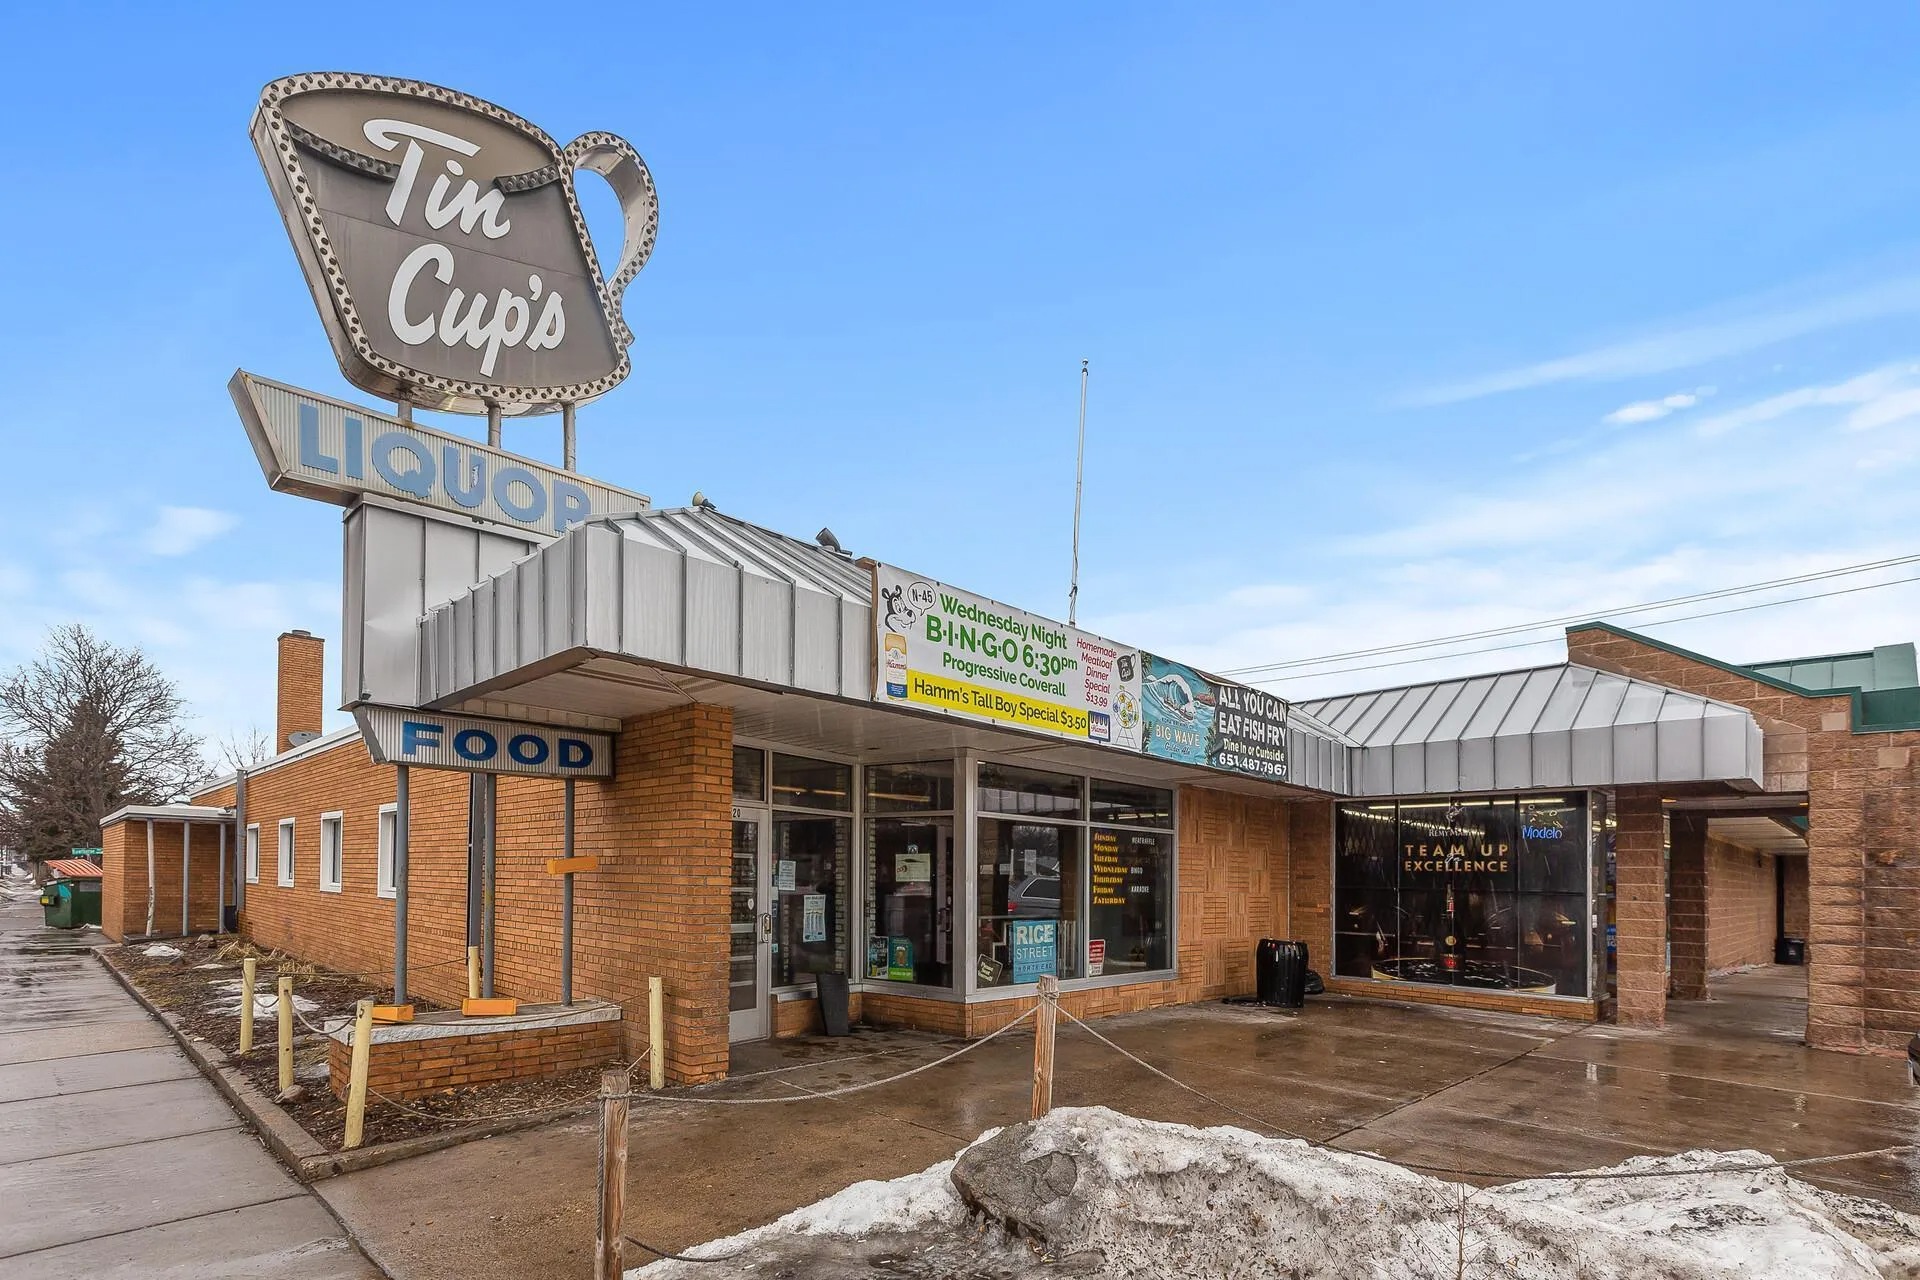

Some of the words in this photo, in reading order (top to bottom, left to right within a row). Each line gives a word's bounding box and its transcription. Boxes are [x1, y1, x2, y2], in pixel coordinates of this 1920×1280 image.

[362, 118, 512, 239] Tin
[387, 243, 566, 378] Cup's
[911, 588, 933, 604] N-45
[939, 592, 1029, 642] Wednesday
[1031, 623, 1068, 650] Night
[1076, 637, 1117, 659] Homemade
[1080, 652, 1113, 672] Meatloaf
[942, 651, 1017, 685] Progressive
[1019, 673, 1067, 697] Coverall
[1086, 666, 1109, 681] Dinner
[1084, 678, 1111, 695] Special
[914, 677, 969, 704] Hamm's
[971, 690, 994, 708] Tall
[995, 696, 1018, 717] Boy
[1019, 705, 1059, 724] Special
[1061, 713, 1087, 731] $3.50
[1085, 691, 1108, 708] $13.99
[1219, 686, 1241, 710] ALL
[1243, 692, 1264, 716] YOU
[1266, 699, 1287, 723] CAN
[1155, 724, 1171, 741] BIG
[1174, 729, 1200, 747] WAVE
[1219, 711, 1242, 736] EAT
[1242, 717, 1265, 742] FISH
[1267, 724, 1286, 747] FRY
[403, 719, 593, 769] FOOD
[1223, 738, 1240, 752] Dine
[1240, 742, 1247, 755] In
[1248, 746, 1255, 757] or
[1255, 745, 1285, 762] Curbside
[1218, 752, 1287, 777] 651.487.7967
[1522, 825, 1563, 840] Modelo
[1405, 843, 1465, 857] TEAM
[1480, 843, 1509, 857] UP
[1404, 860, 1508, 872] EXCELLENCE
[1016, 924, 1054, 945] RICE
[1016, 945, 1054, 960] STREET
